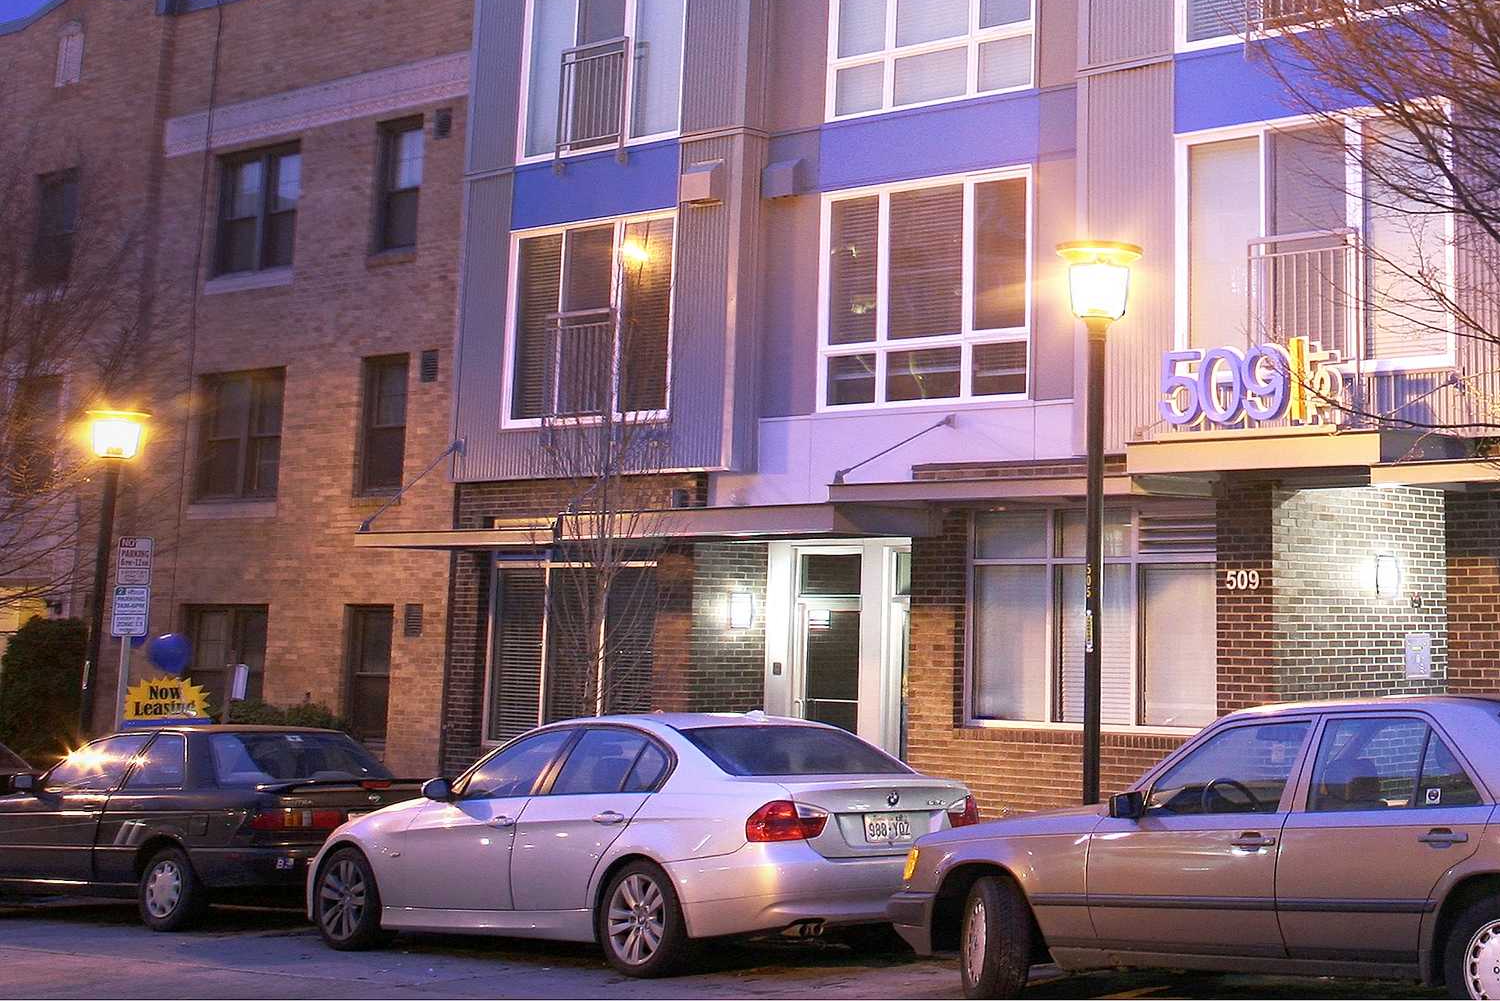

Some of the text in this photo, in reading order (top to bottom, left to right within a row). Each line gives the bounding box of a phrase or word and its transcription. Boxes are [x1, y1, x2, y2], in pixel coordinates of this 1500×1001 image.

[1159, 343, 1291, 425] 509
[1226, 570, 1260, 590] 509
[149, 686, 181, 700] Now
